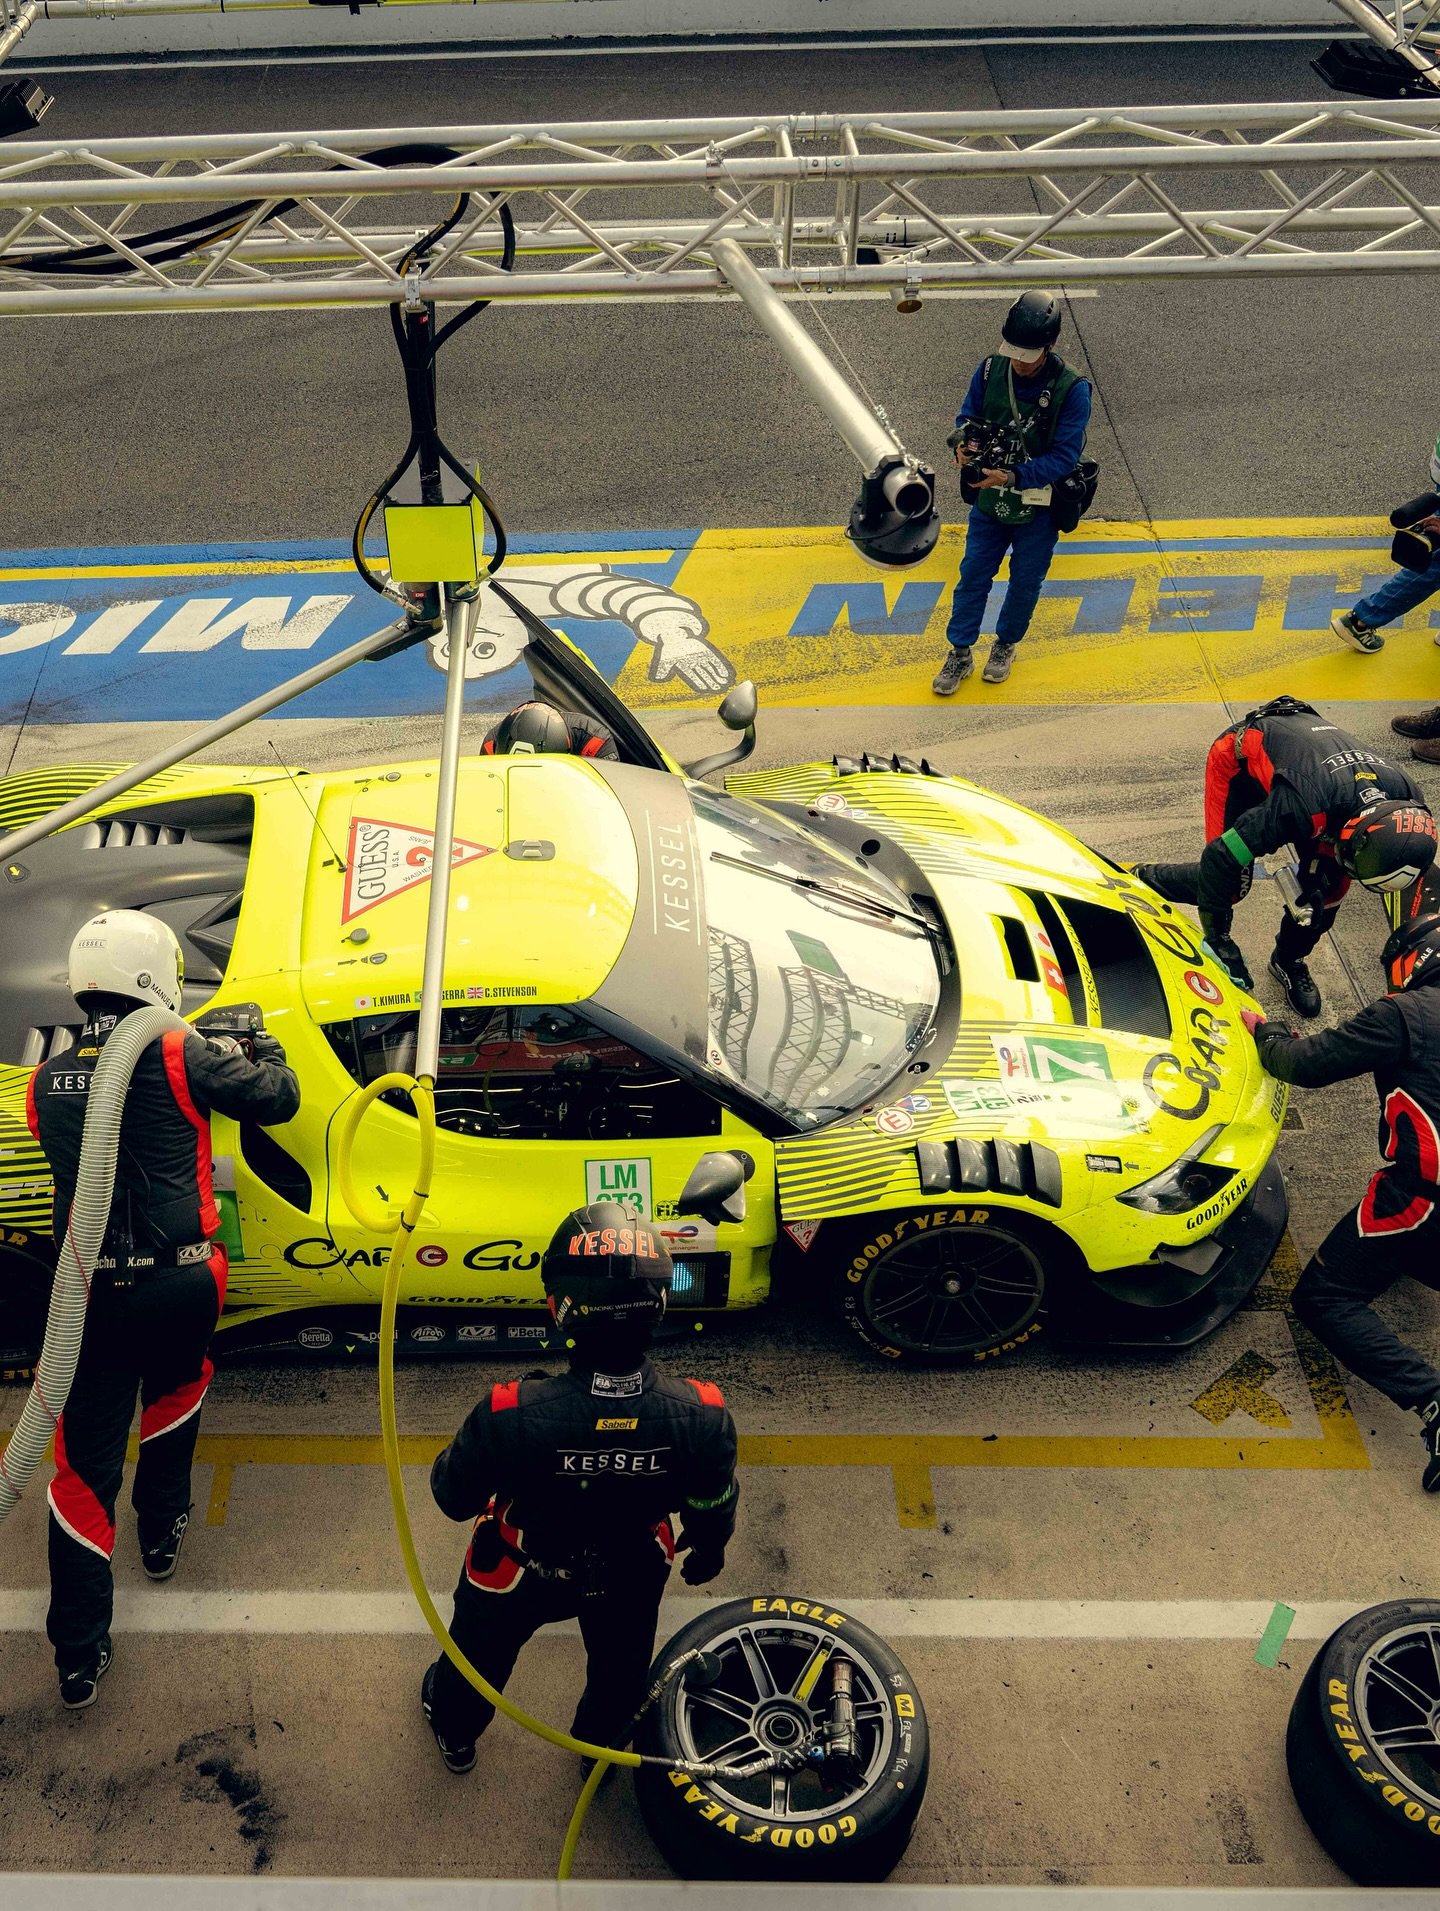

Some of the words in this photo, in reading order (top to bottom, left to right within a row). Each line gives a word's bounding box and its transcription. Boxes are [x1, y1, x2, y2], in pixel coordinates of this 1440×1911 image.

[357, 828, 390, 900] GUESS
[661, 823, 691, 932] KESSEL
[151, 982, 173, 1009] MANUEL
[373, 993, 411, 1007] T.KIMURA
[441, 989, 465, 1000] SERRA
[485, 986, 537, 999] C.STEVENSON
[81, 1047, 102, 1056] Sabe
[53, 1076, 94, 1090] KES
[600, 1164, 637, 1190] LM
[569, 1228, 659, 1258] KESSEL
[463, 1240, 541, 1271] GU
[408, 1295, 548, 1305] GOODYEA
[518, 1328, 545, 1338] Beta
[601, 1420, 633, 1429] Sabelt
[563, 1454, 661, 1471] KESSEL
[752, 1598, 847, 1629] EAGLE
